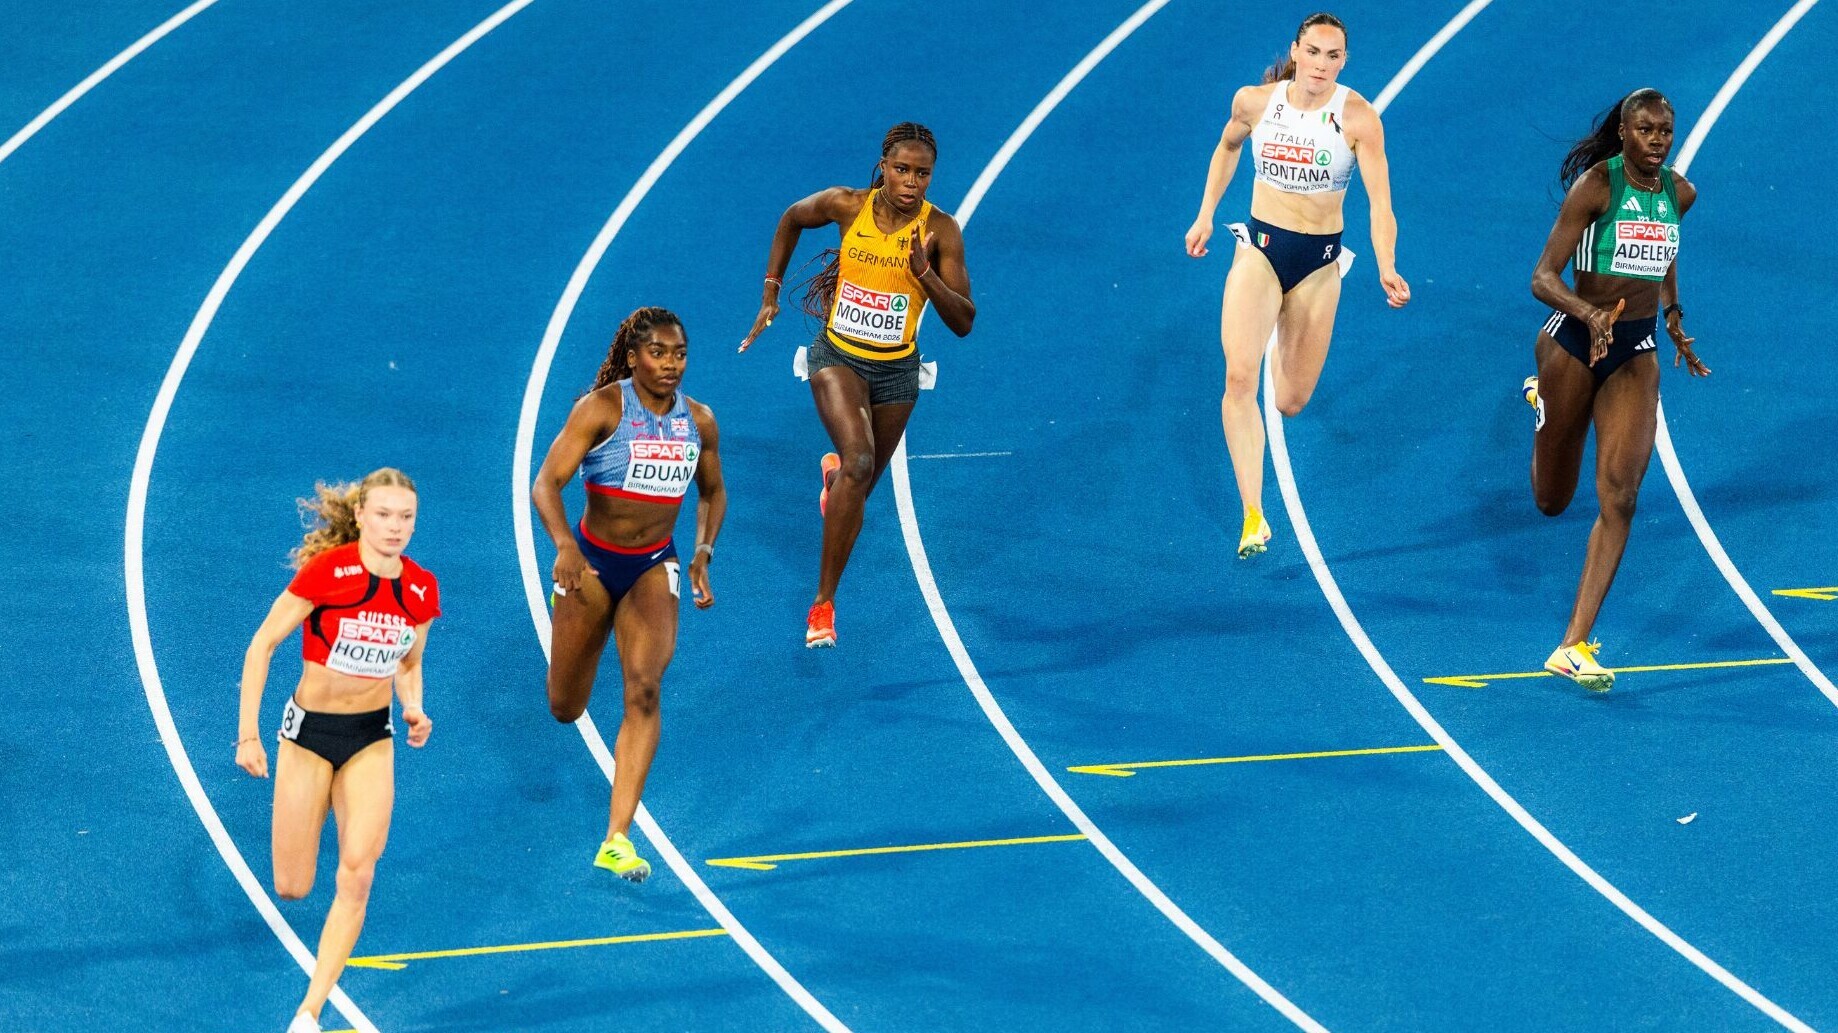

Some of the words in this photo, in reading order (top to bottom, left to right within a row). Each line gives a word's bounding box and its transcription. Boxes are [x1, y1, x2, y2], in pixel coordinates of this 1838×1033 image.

[1274, 132, 1315, 147] ITALIA
[1263, 145, 1313, 162] SPAR
[1262, 161, 1331, 182] FONTANA
[1310, 183, 1329, 191] 2026
[1619, 224, 1666, 240] SPAR
[848, 247, 910, 269] GERMANY
[1614, 243, 1677, 262] ADELEKE
[1614, 261, 1662, 273] BIRMINGHAM
[842, 284, 889, 310] SPAR
[836, 302, 905, 331] MOKOBE
[834, 322, 882, 340] BIRMINGHAM
[634, 444, 684, 460] SPAR
[631, 463, 693, 482] EDUAN
[627, 481, 679, 494] BIRMINGHAM
[342, 622, 399, 645] SPAR
[284, 707, 295, 732] 8
